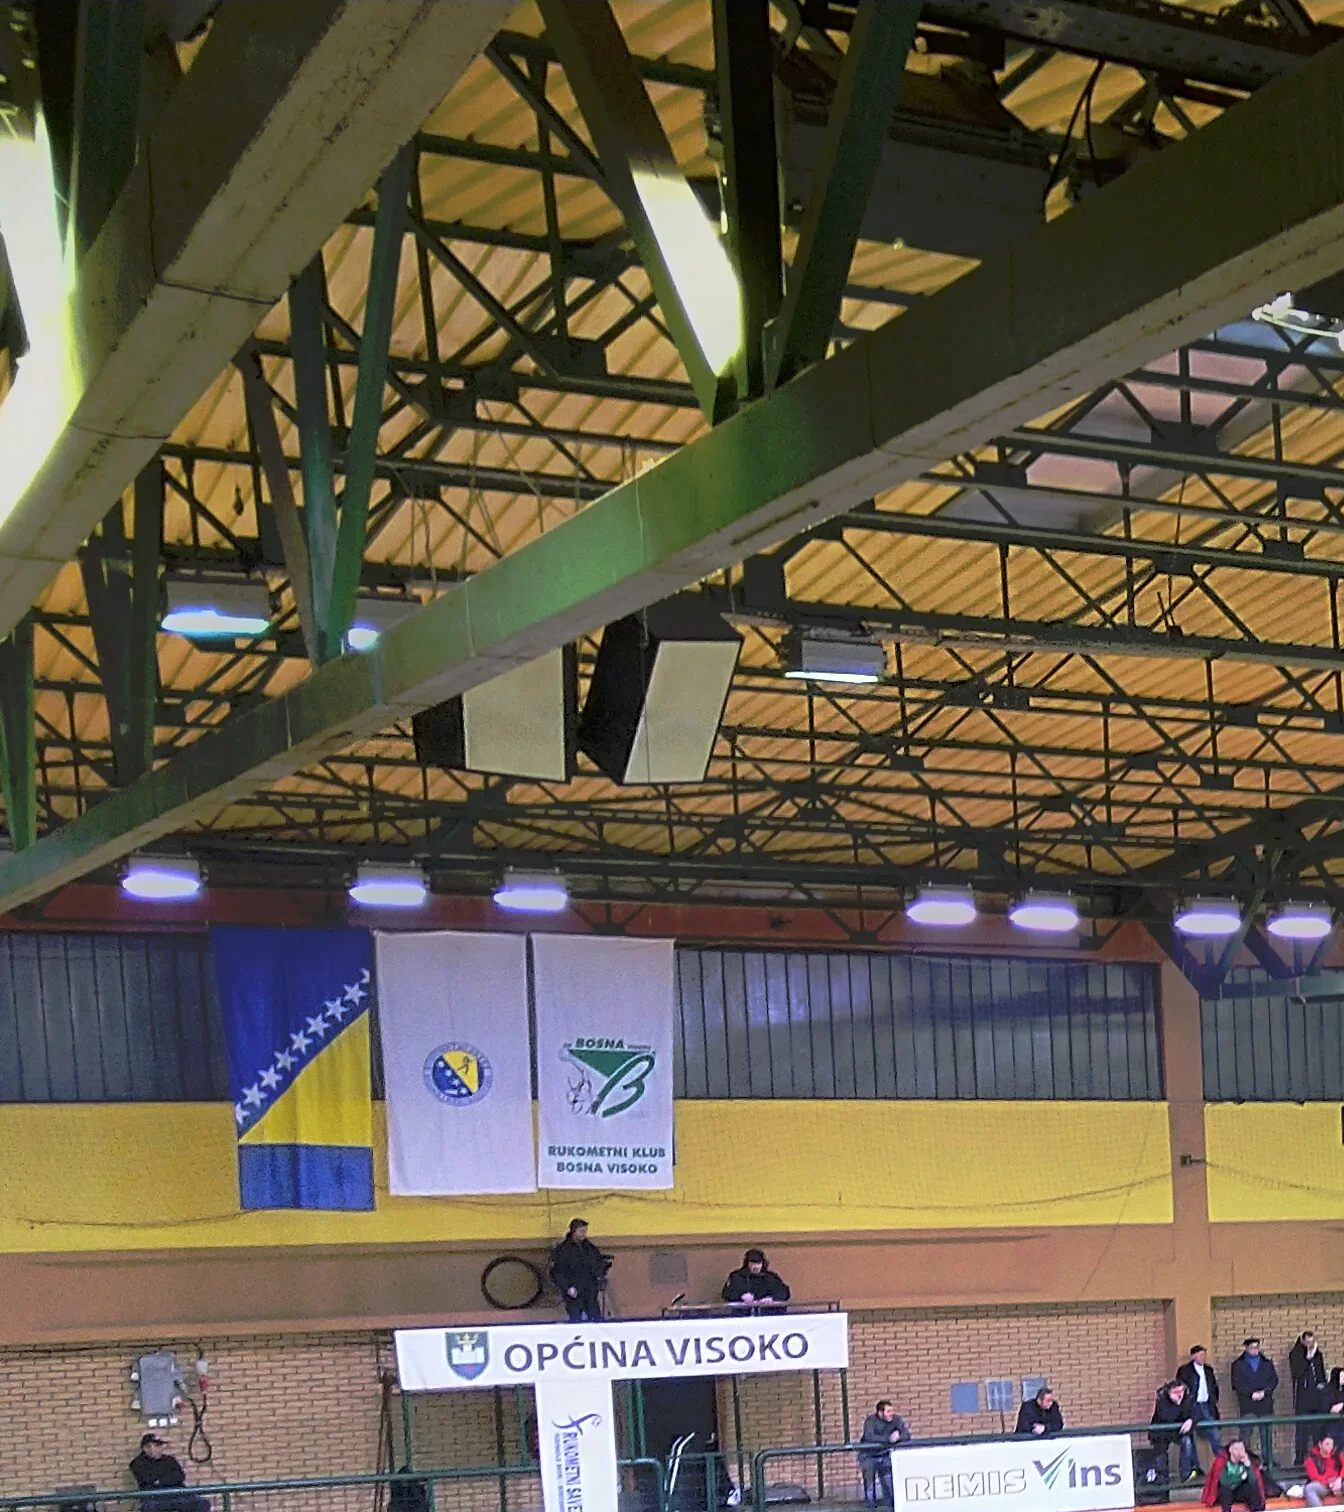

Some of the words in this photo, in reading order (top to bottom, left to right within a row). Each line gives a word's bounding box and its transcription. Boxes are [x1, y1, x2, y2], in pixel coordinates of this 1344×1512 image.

[575, 1037, 625, 1049] BOSNA
[548, 1145, 628, 1158] RUKOMETNI
[633, 1147, 666, 1158] KLUB
[556, 1162, 603, 1174] BOSNA
[607, 1163, 658, 1174] VISOKO
[503, 1335, 657, 1373] OPĆINA
[667, 1331, 810, 1366] VISOKO
[904, 1468, 1027, 1502] REMIS
